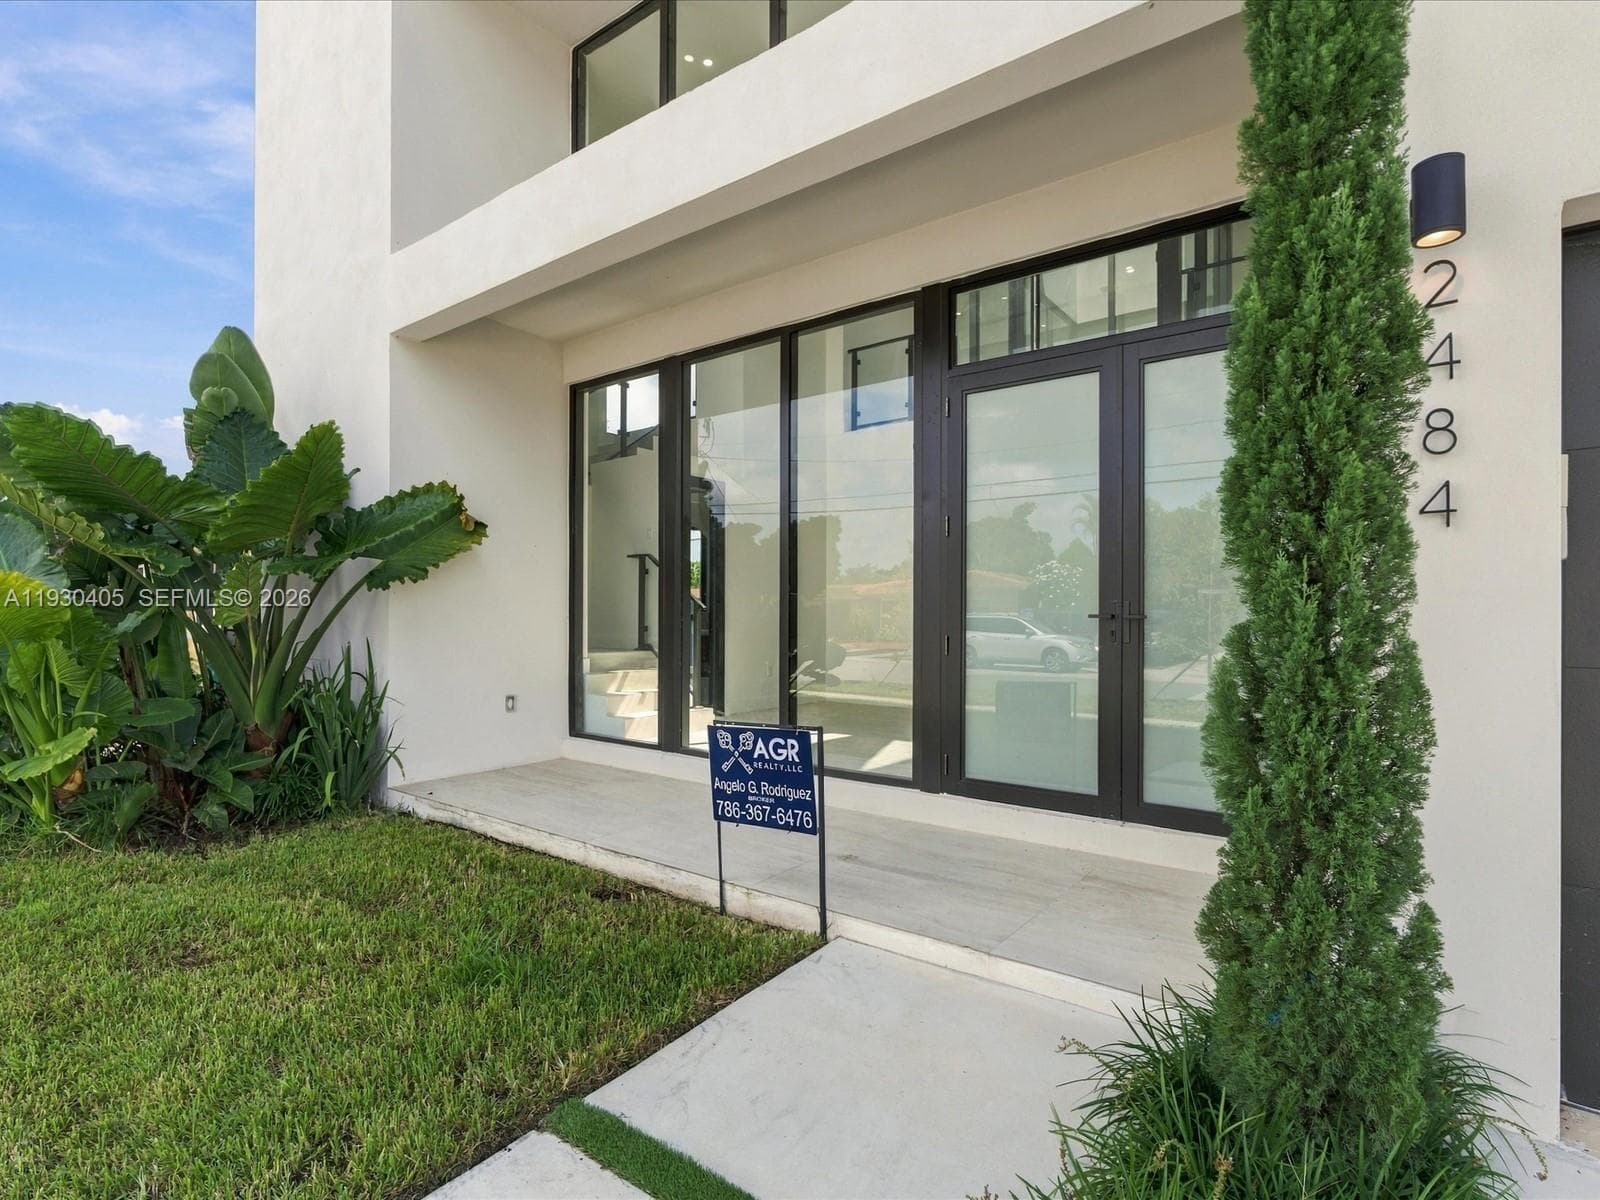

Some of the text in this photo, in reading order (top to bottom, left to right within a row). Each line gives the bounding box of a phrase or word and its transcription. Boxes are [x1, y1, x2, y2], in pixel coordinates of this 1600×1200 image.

[1419, 260, 1461, 527] 2484
[753, 737, 800, 762] AGR
[714, 777, 812, 801] Angelo G. Rodriguez
[716, 800, 812, 829] 786-367-6476
